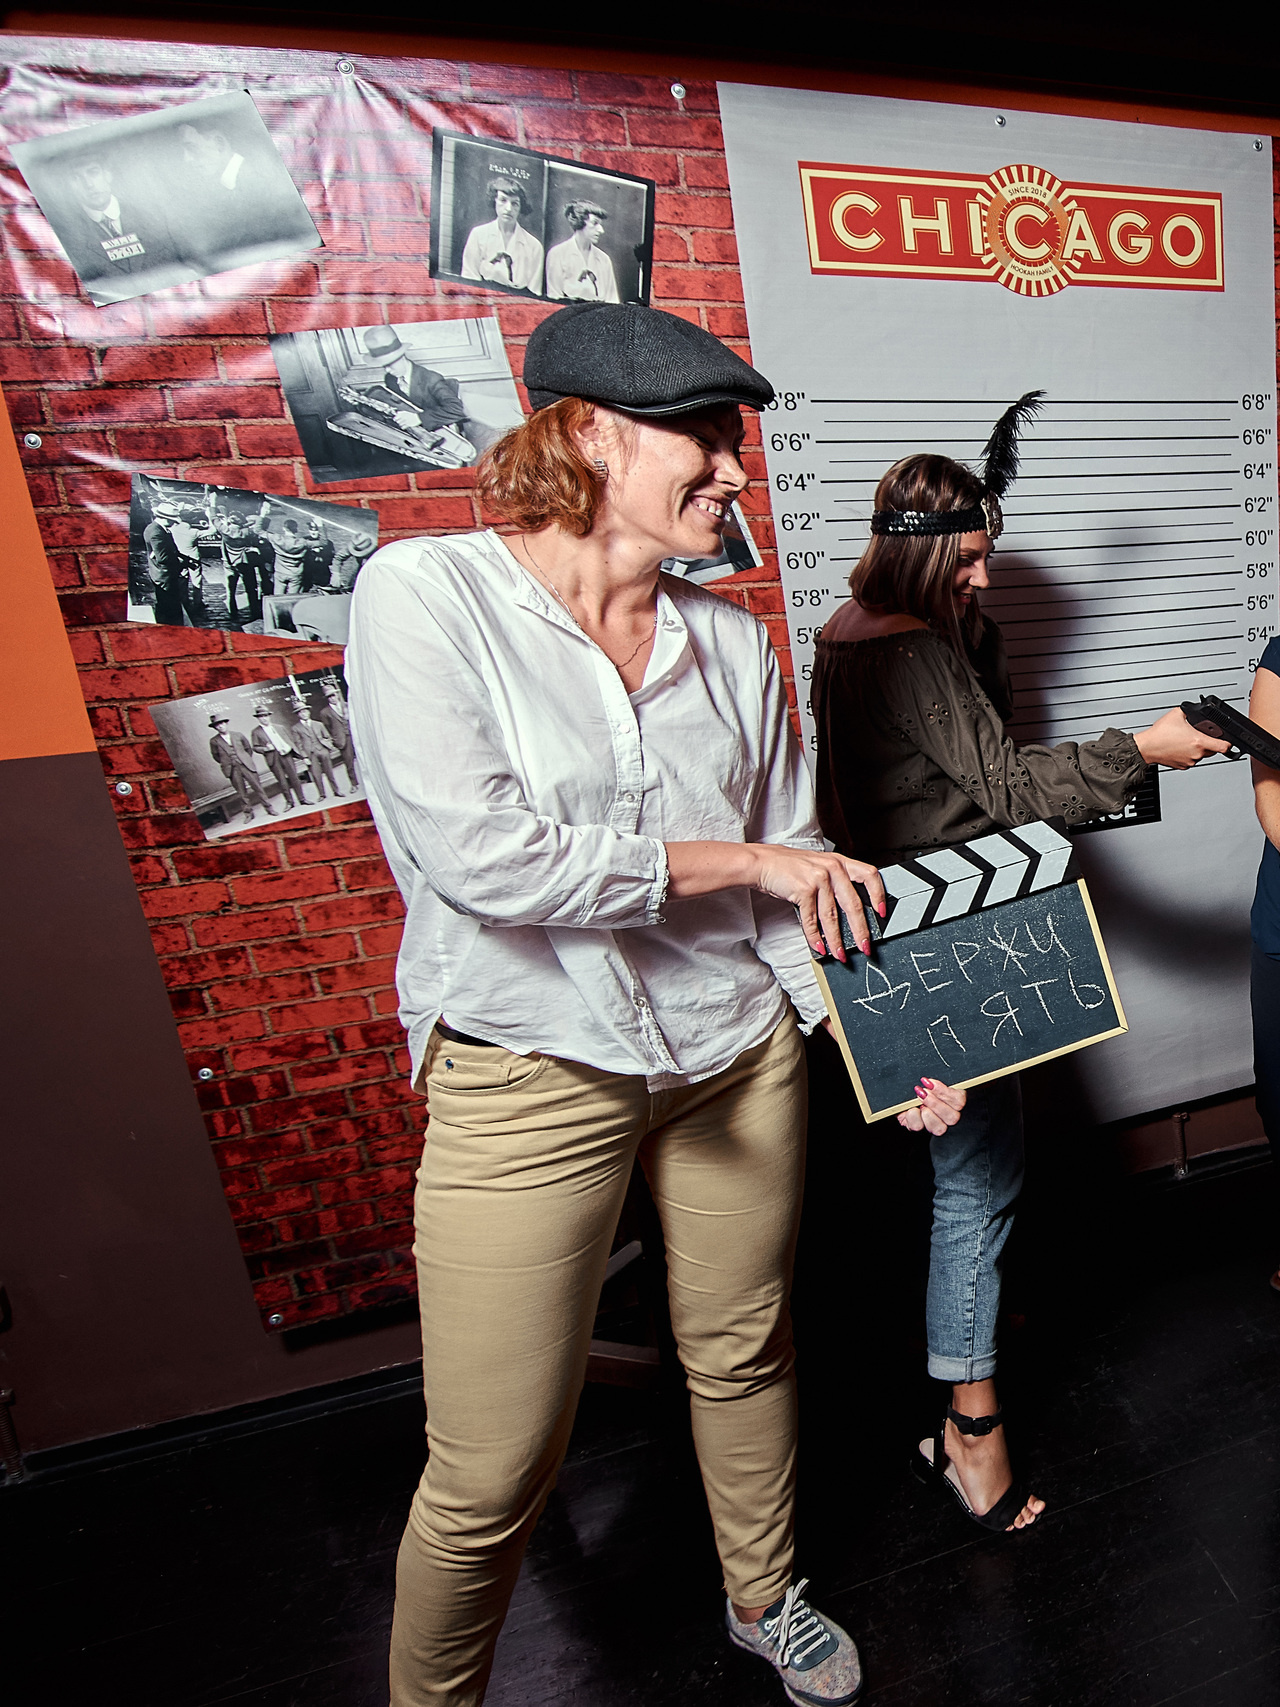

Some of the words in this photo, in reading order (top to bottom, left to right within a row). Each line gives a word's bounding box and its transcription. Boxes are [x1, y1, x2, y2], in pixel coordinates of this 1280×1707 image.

[1008, 186, 1029, 196] SINCE
[1031, 187, 1047, 199] 2018
[829, 190, 1206, 268] CHICAGO
[1010, 263, 1036, 276] HOOKAH
[1036, 266, 1054, 276] FAMILY
[1242, 394, 1271, 410] 6'8"
[771, 433, 810, 451] 6'6"
[1243, 429, 1271, 445] 6'6"
[1243, 463, 1272, 479] 6'4"
[776, 473, 815, 491] 6'4"
[1244, 496, 1273, 513] 6'2"
[781, 512, 820, 531] 6'2"
[1245, 530, 1273, 546] 6'0"
[786, 551, 825, 569] 6'0"
[1246, 562, 1274, 578] 5'8"
[792, 589, 829, 607] 5'8"
[1247, 594, 1274, 610] 5'6"
[1247, 626, 1275, 642] 5'4"
[852, 913, 1072, 1015] ДЕРЖИ
[926, 968, 1106, 1068] ПЯТЬ
